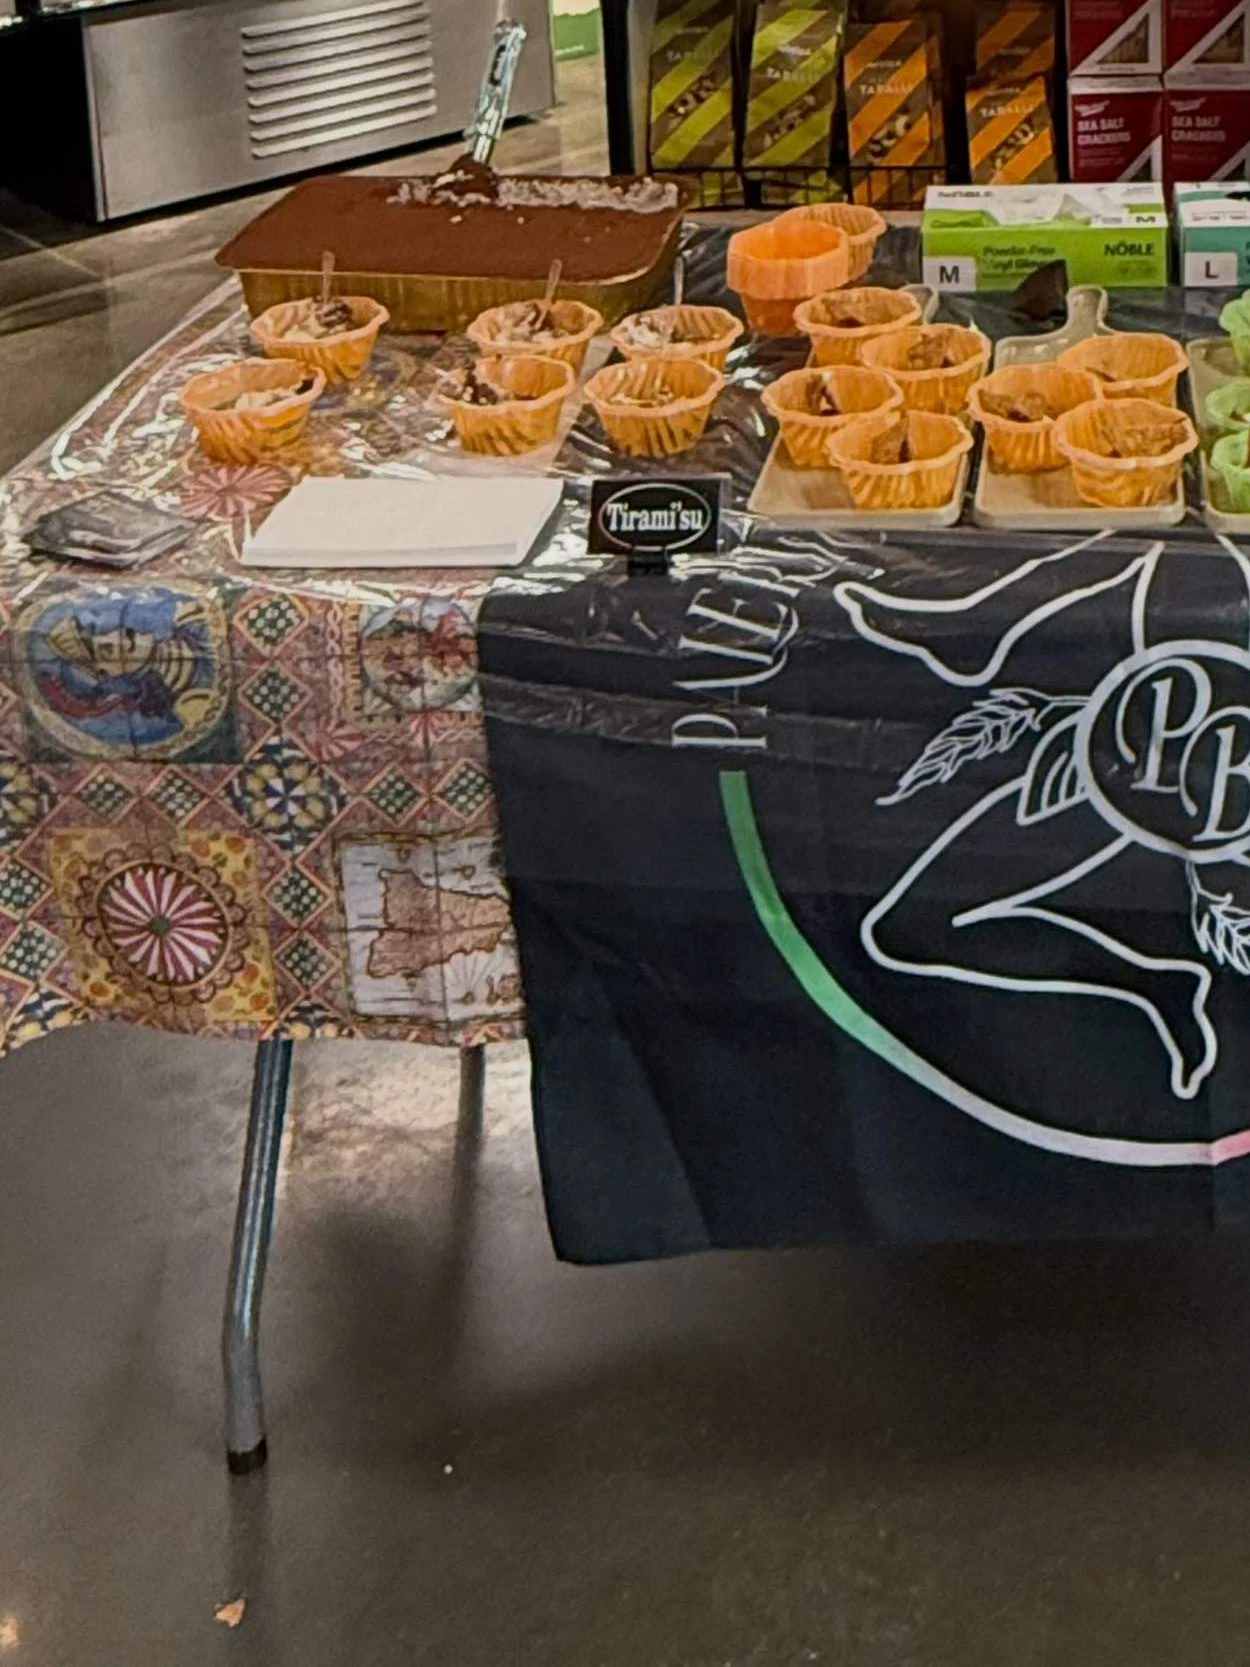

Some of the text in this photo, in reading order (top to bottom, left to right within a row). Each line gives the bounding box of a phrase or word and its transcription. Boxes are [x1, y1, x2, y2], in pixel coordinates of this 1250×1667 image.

[938, 265, 960, 284] M
[1204, 260, 1219, 280] L
[606, 500, 703, 532] Tirami'su
